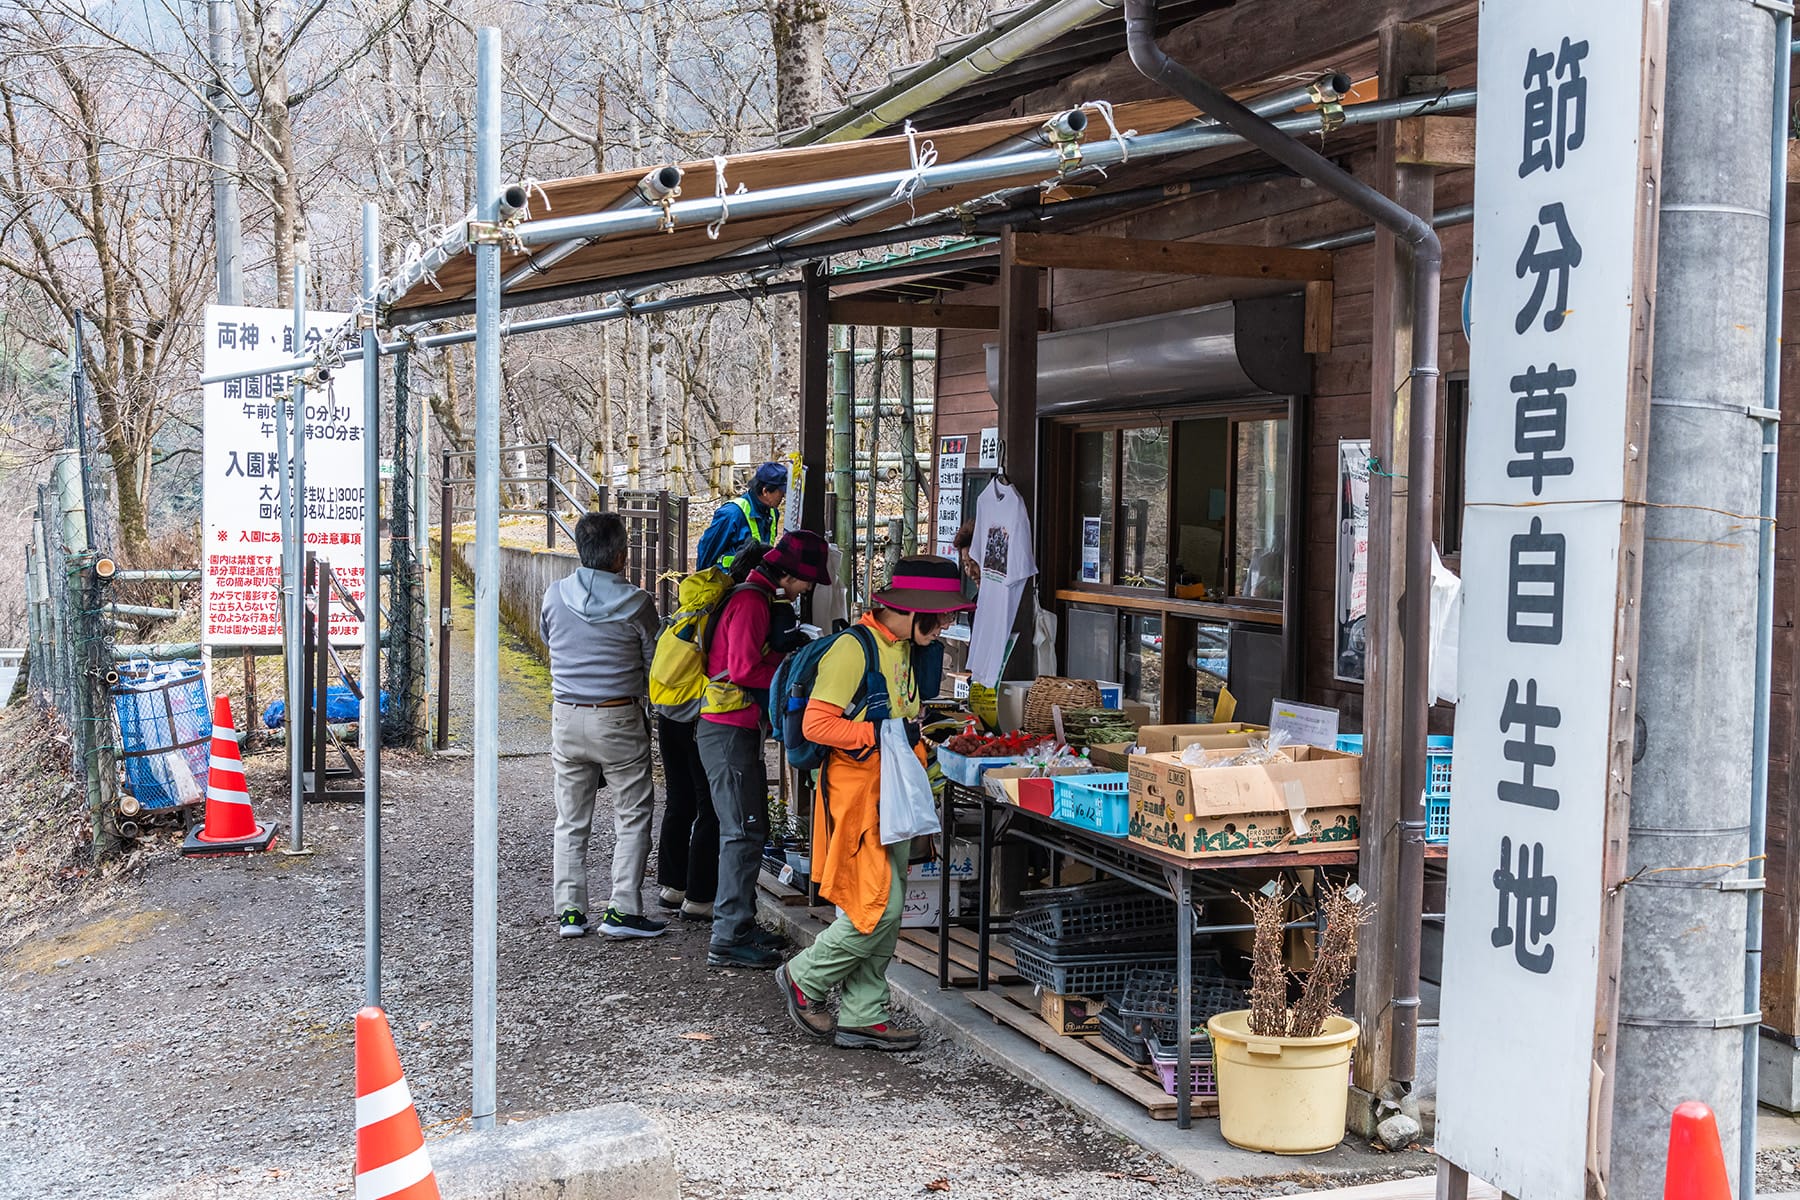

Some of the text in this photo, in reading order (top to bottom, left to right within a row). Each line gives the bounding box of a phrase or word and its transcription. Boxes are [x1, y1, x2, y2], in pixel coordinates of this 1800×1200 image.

[217, 321, 364, 353] 両神・節分園
[242, 402, 351, 422] 午前8時0分より
[1491, 36, 1590, 975] 節分草自生地
[239, 530, 362, 546] 入園にあの注意事項
[921, 857, 973, 874] 鮮んま
